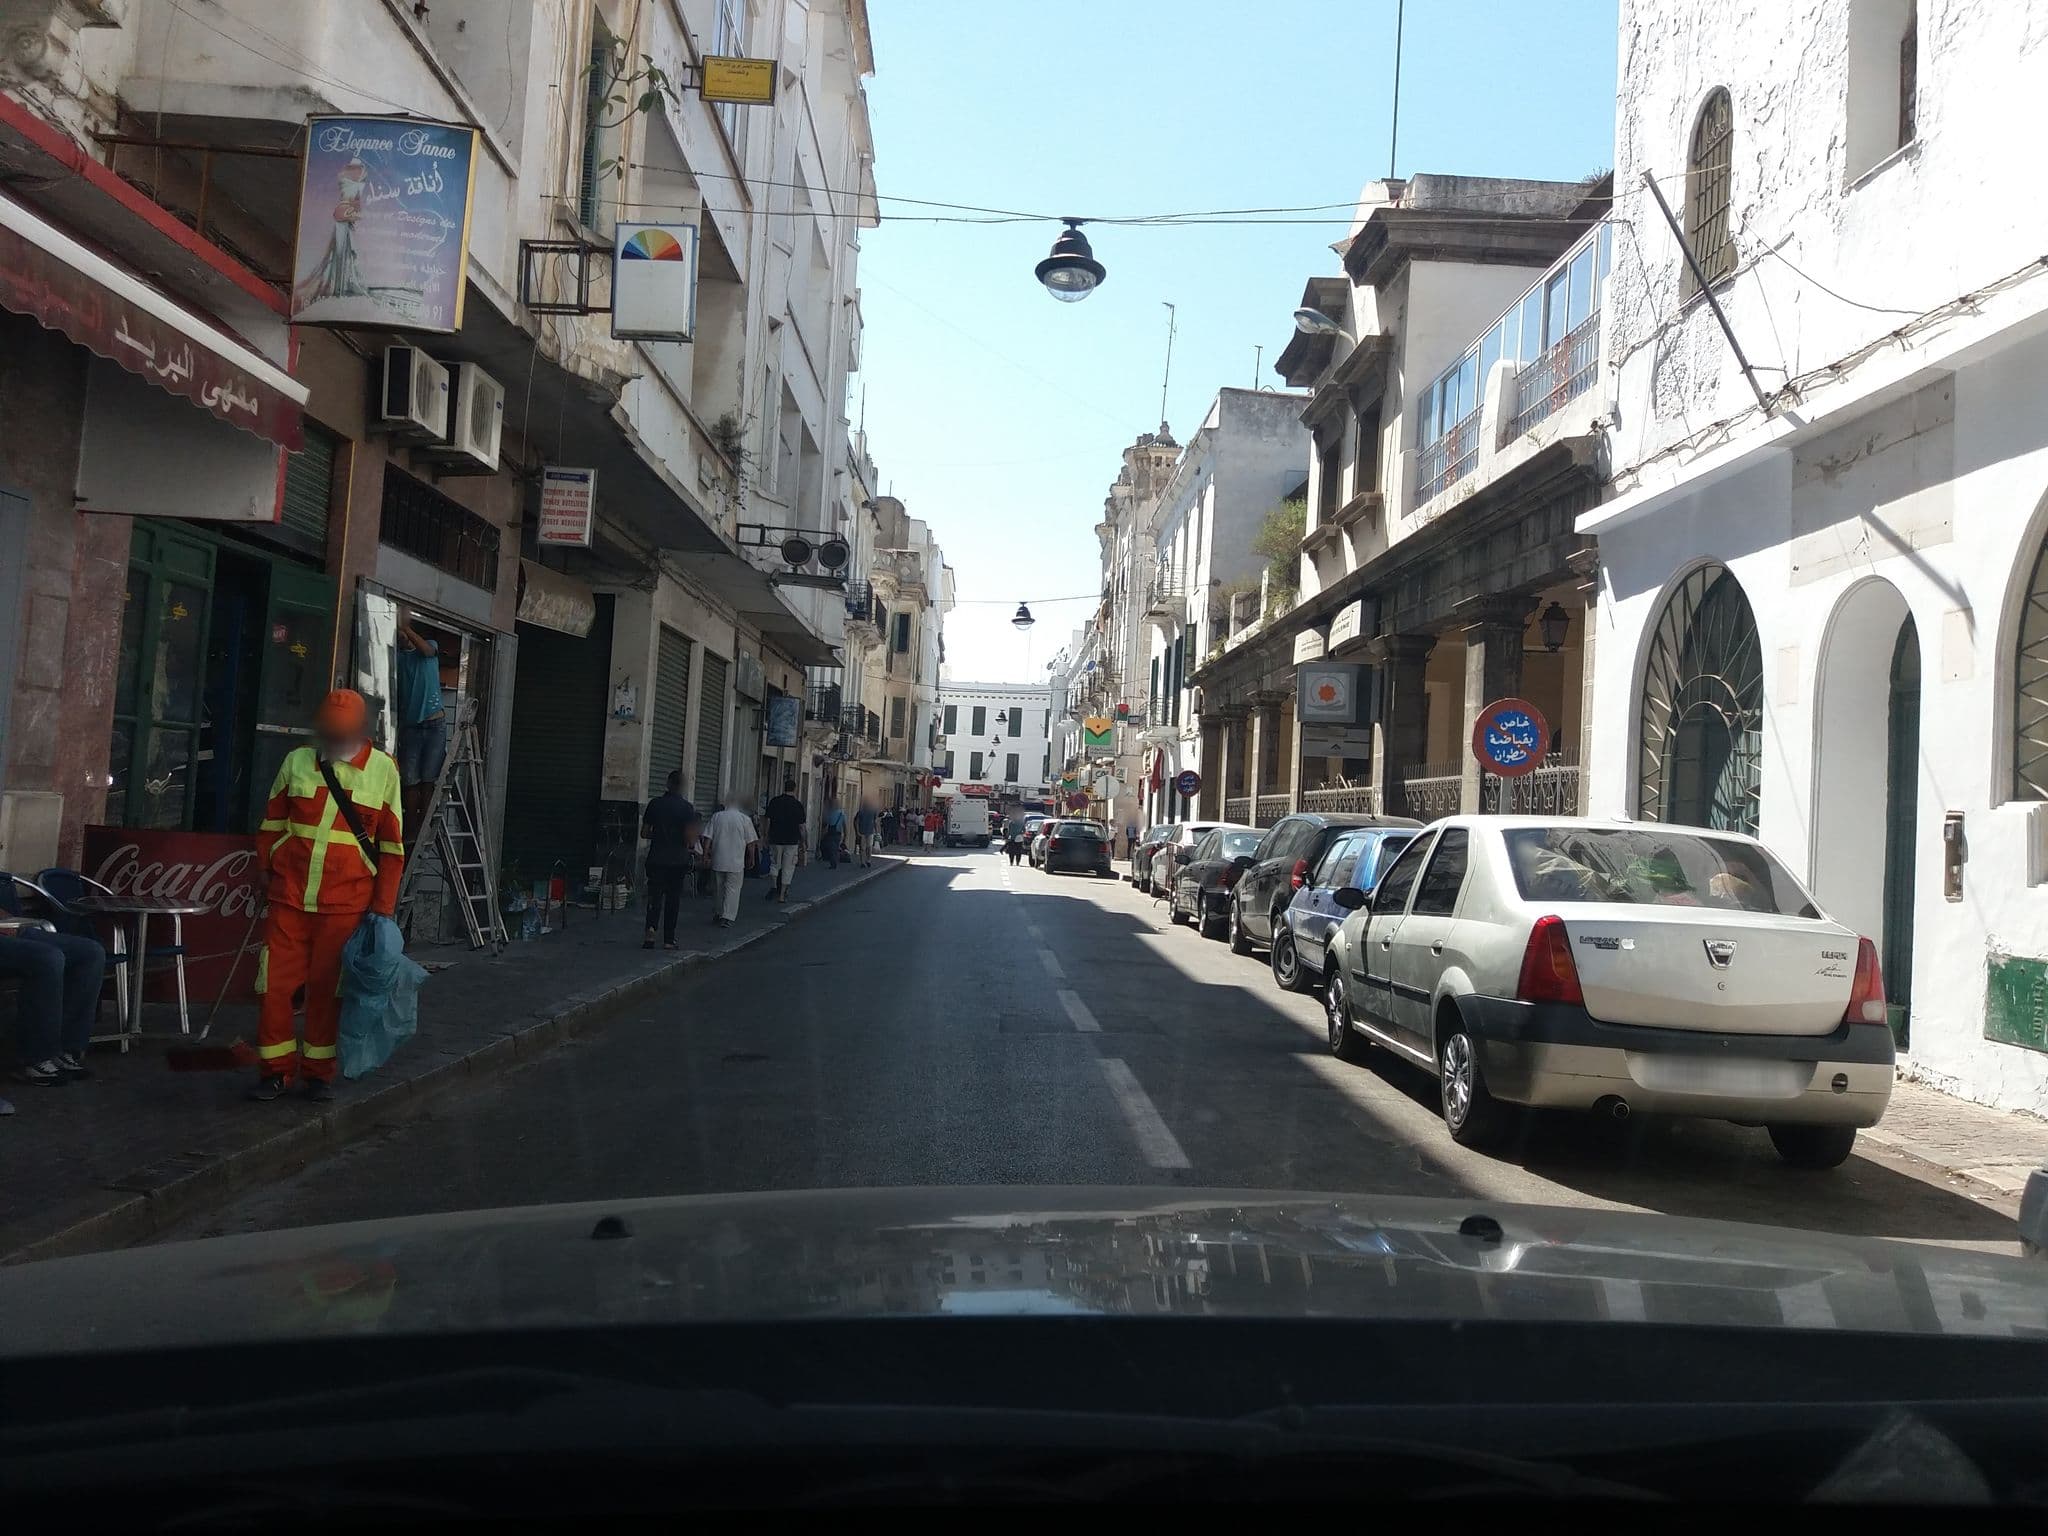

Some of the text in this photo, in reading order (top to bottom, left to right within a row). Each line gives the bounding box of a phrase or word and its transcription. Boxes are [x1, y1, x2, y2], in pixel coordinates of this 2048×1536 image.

[319, 126, 456, 160] Elegance Sanae
[114, 314, 195, 384] البريد
[1500, 715, 1530, 732] خاص
[1494, 747, 1527, 763] تطوان
[90, 843, 269, 919] Coca-Co
